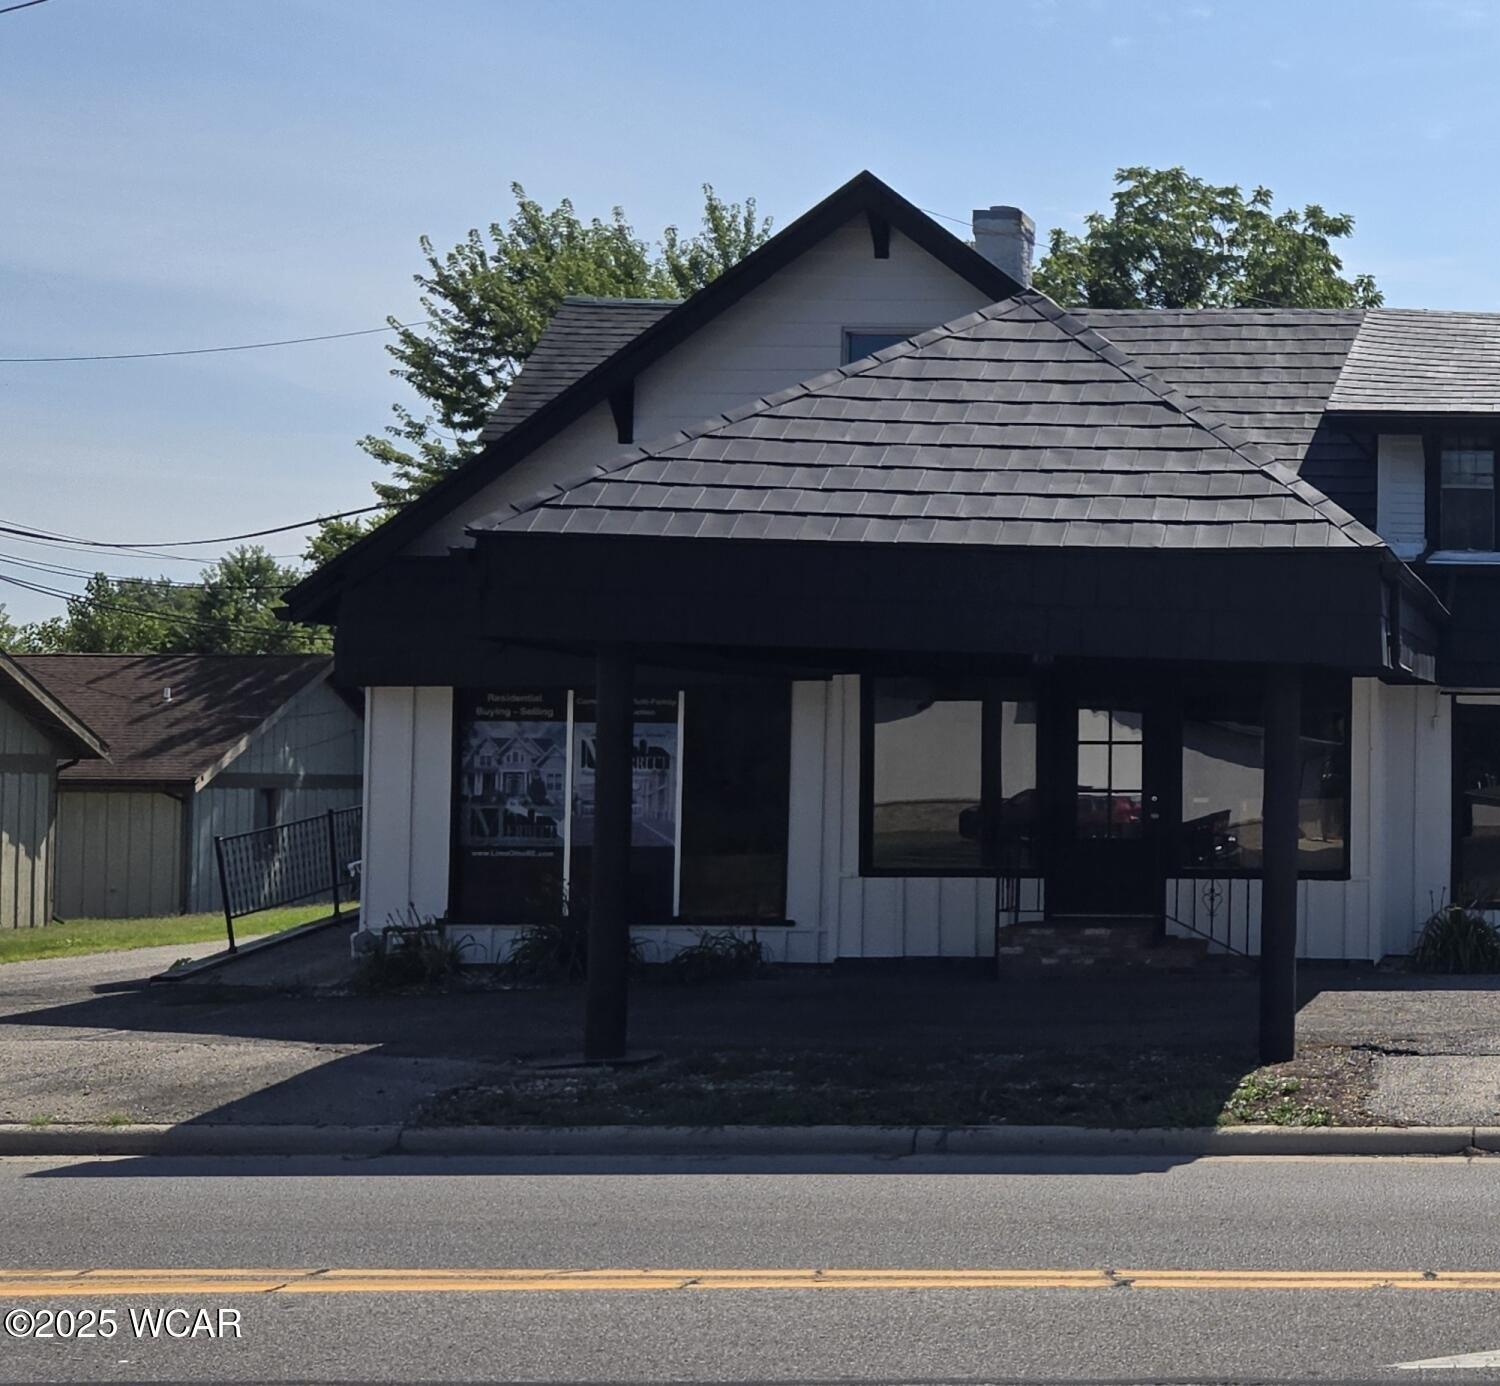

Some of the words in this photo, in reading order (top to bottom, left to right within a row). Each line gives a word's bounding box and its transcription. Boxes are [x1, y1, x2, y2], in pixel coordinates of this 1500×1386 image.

[487, 692, 543, 703] Residential
[475, 706, 512, 719] Buying
[519, 706, 555, 719] Selling
